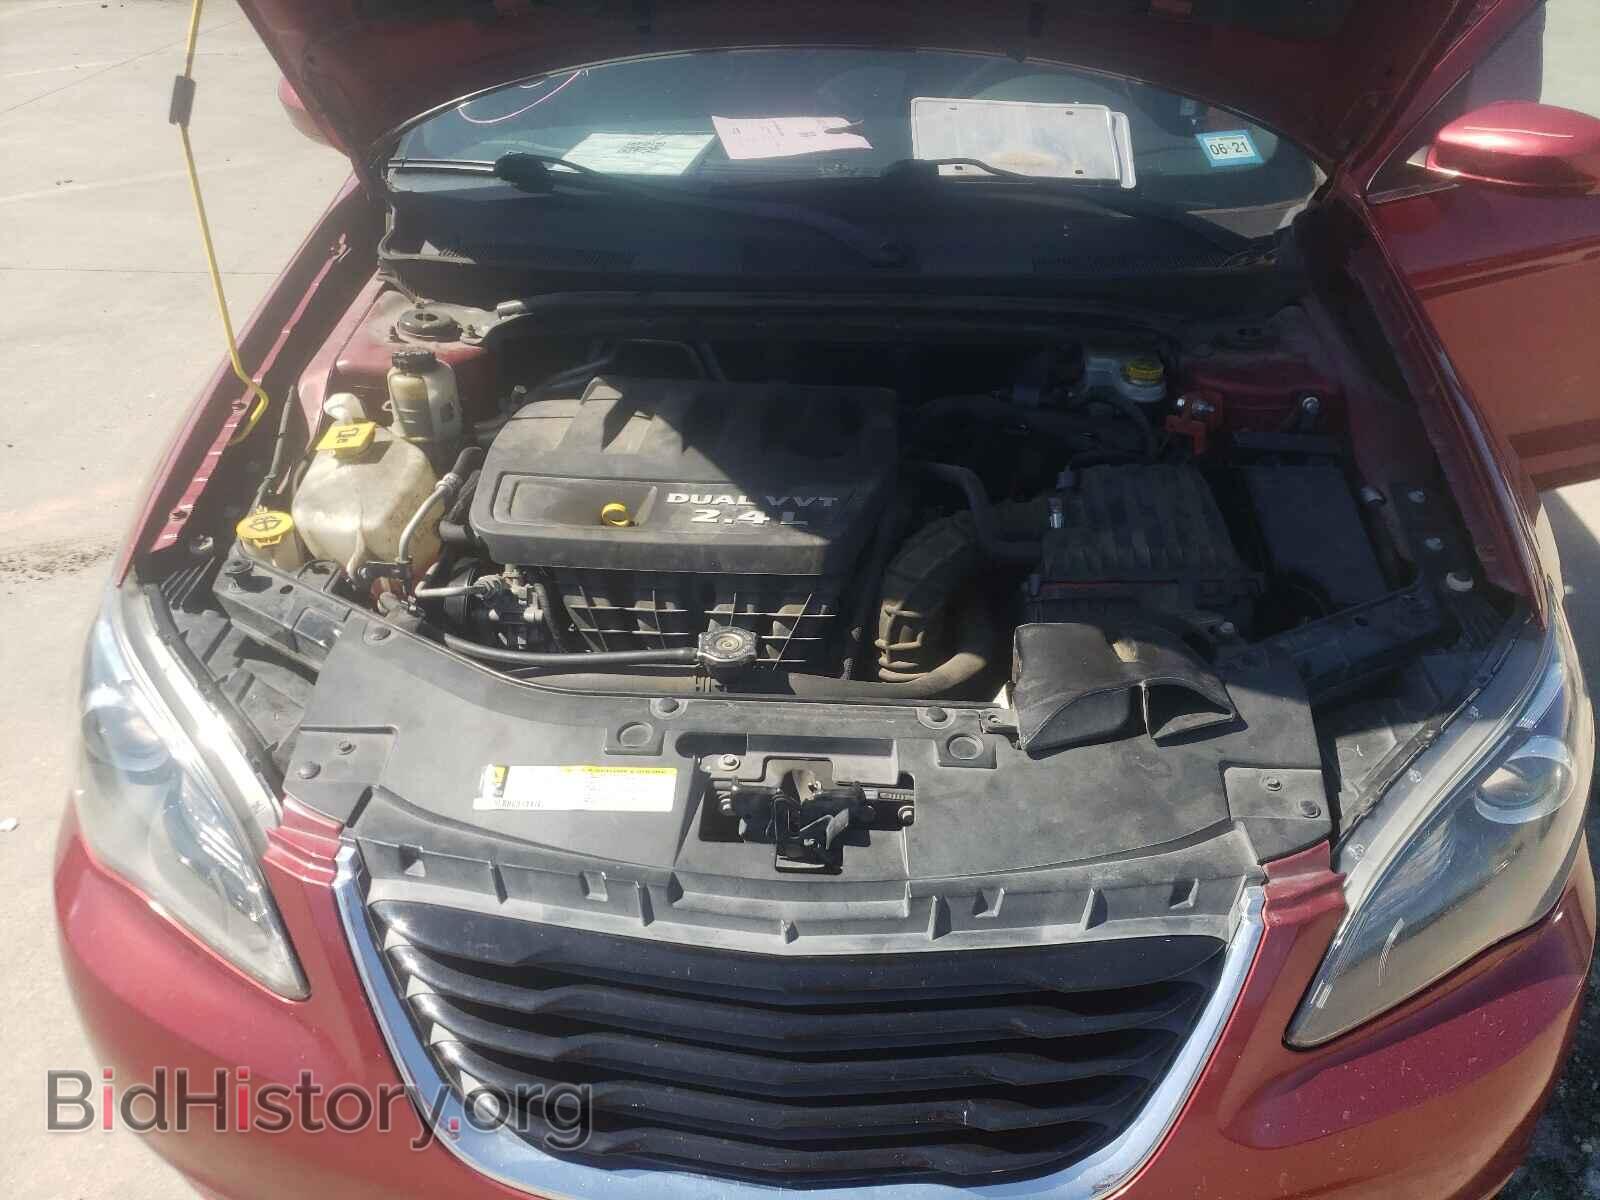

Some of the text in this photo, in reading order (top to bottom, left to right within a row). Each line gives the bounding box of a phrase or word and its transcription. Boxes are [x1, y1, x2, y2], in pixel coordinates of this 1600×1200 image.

[666, 493, 839, 508] DUAL VVT
[690, 509, 809, 526] 2.4 L
